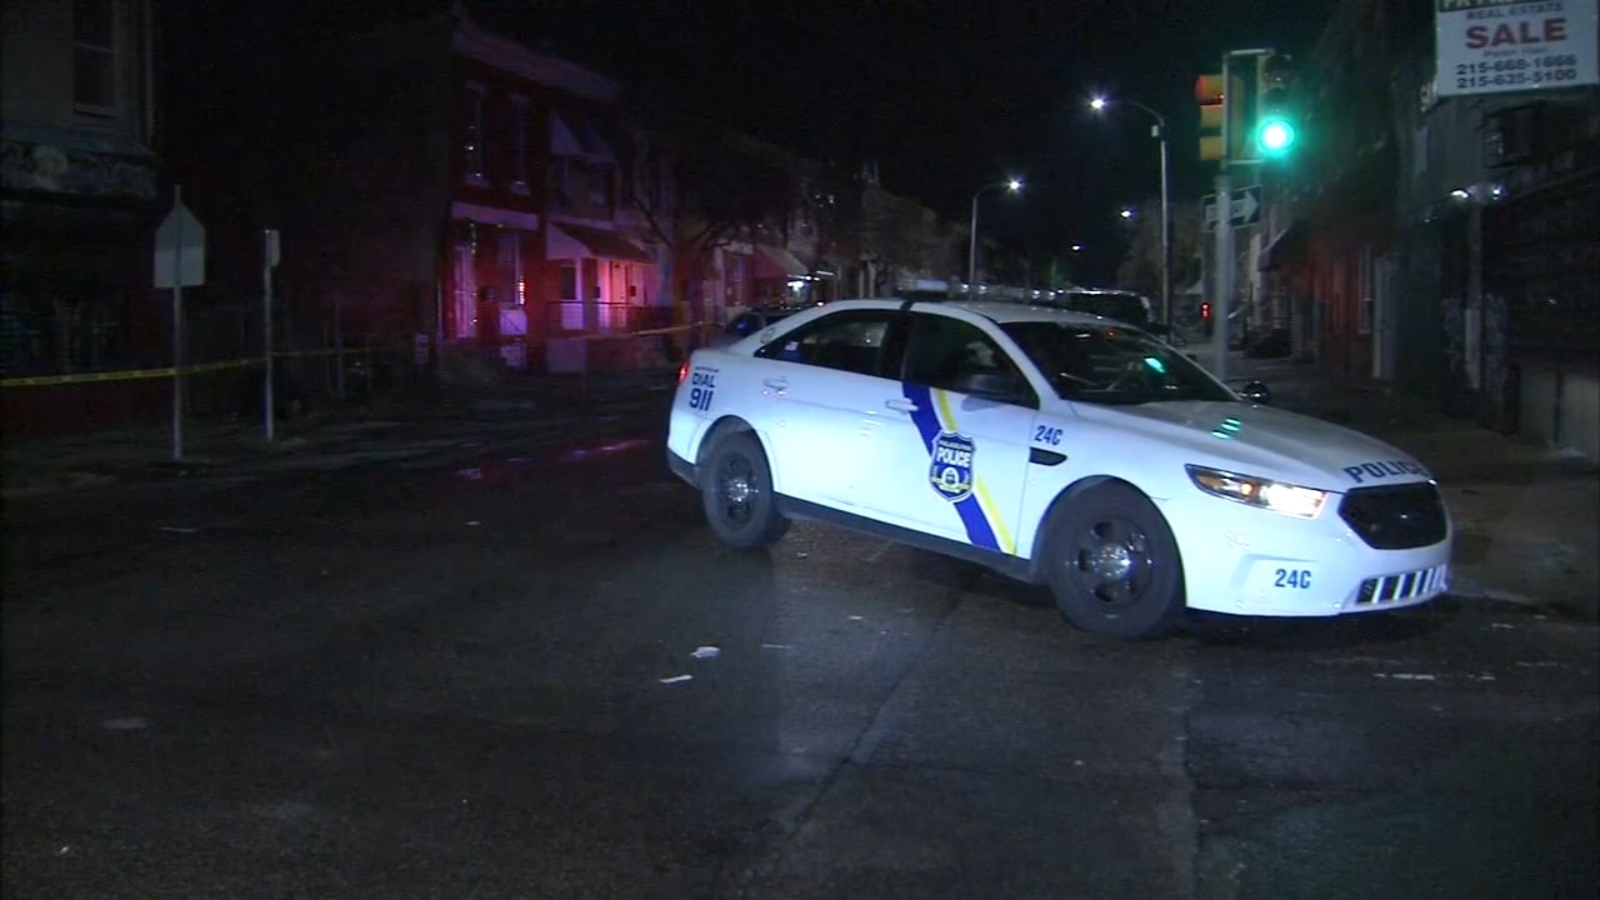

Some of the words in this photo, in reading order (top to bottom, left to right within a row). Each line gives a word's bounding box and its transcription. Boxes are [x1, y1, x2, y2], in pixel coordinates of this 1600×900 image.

[1467, 9, 1504, 20] REAL
[1509, 2, 1563, 16] ESTATE
[1466, 17, 1567, 49] SALE
[692, 372, 716, 388] DIAL
[689, 387, 714, 411] 911
[1034, 425, 1064, 446] 24C
[935, 446, 972, 468] POLICE
[1274, 568, 1312, 589] 24C
